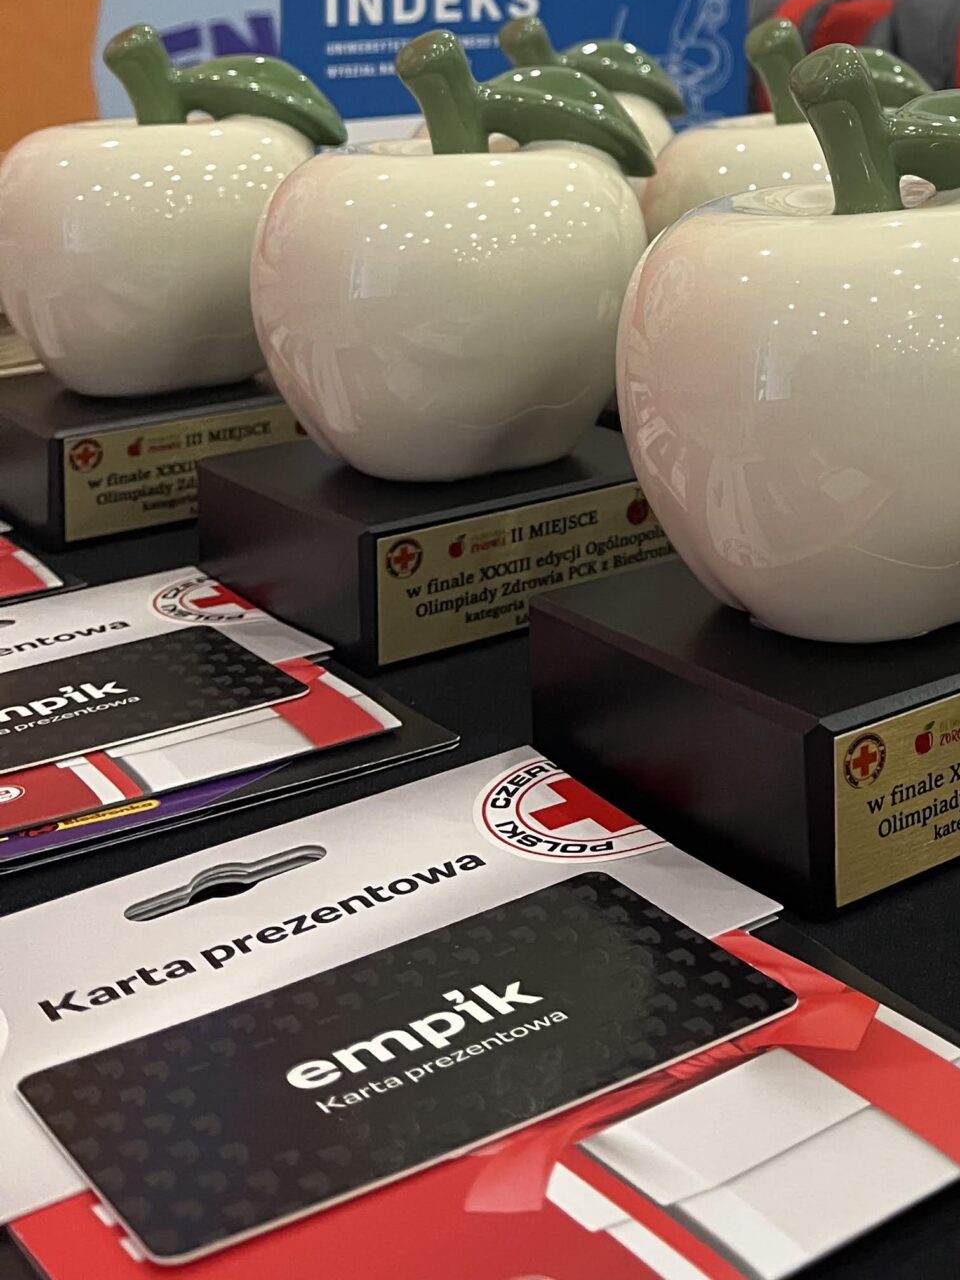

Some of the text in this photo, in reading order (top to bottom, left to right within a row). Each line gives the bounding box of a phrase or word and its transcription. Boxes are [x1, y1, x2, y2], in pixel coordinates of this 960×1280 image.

[186, 432, 202, 448] III
[208, 422, 272, 444] MIEJSCE
[96, 481, 173, 506] Olimpiady
[107, 469, 150, 487] finale
[511, 527, 524, 544] II
[529, 510, 599, 540] MIEJSCE
[406, 525, 666, 599] w finale XXXIII edycji Ogólnopol
[415, 541, 677, 618] Olimpiady Zdrowia PCK z Biedronk
[465, 599, 525, 624] kategoria
[14, 696, 141, 732] prezentowa
[490, 760, 551, 809] CZER
[866, 795, 885, 814] w
[890, 772, 945, 807] finale
[495, 820, 615, 854] POLSKI
[37, 850, 487, 1022] Karta prezentowa
[286, 981, 544, 1089] empik
[315, 1010, 569, 1114] Karta prezentowa
